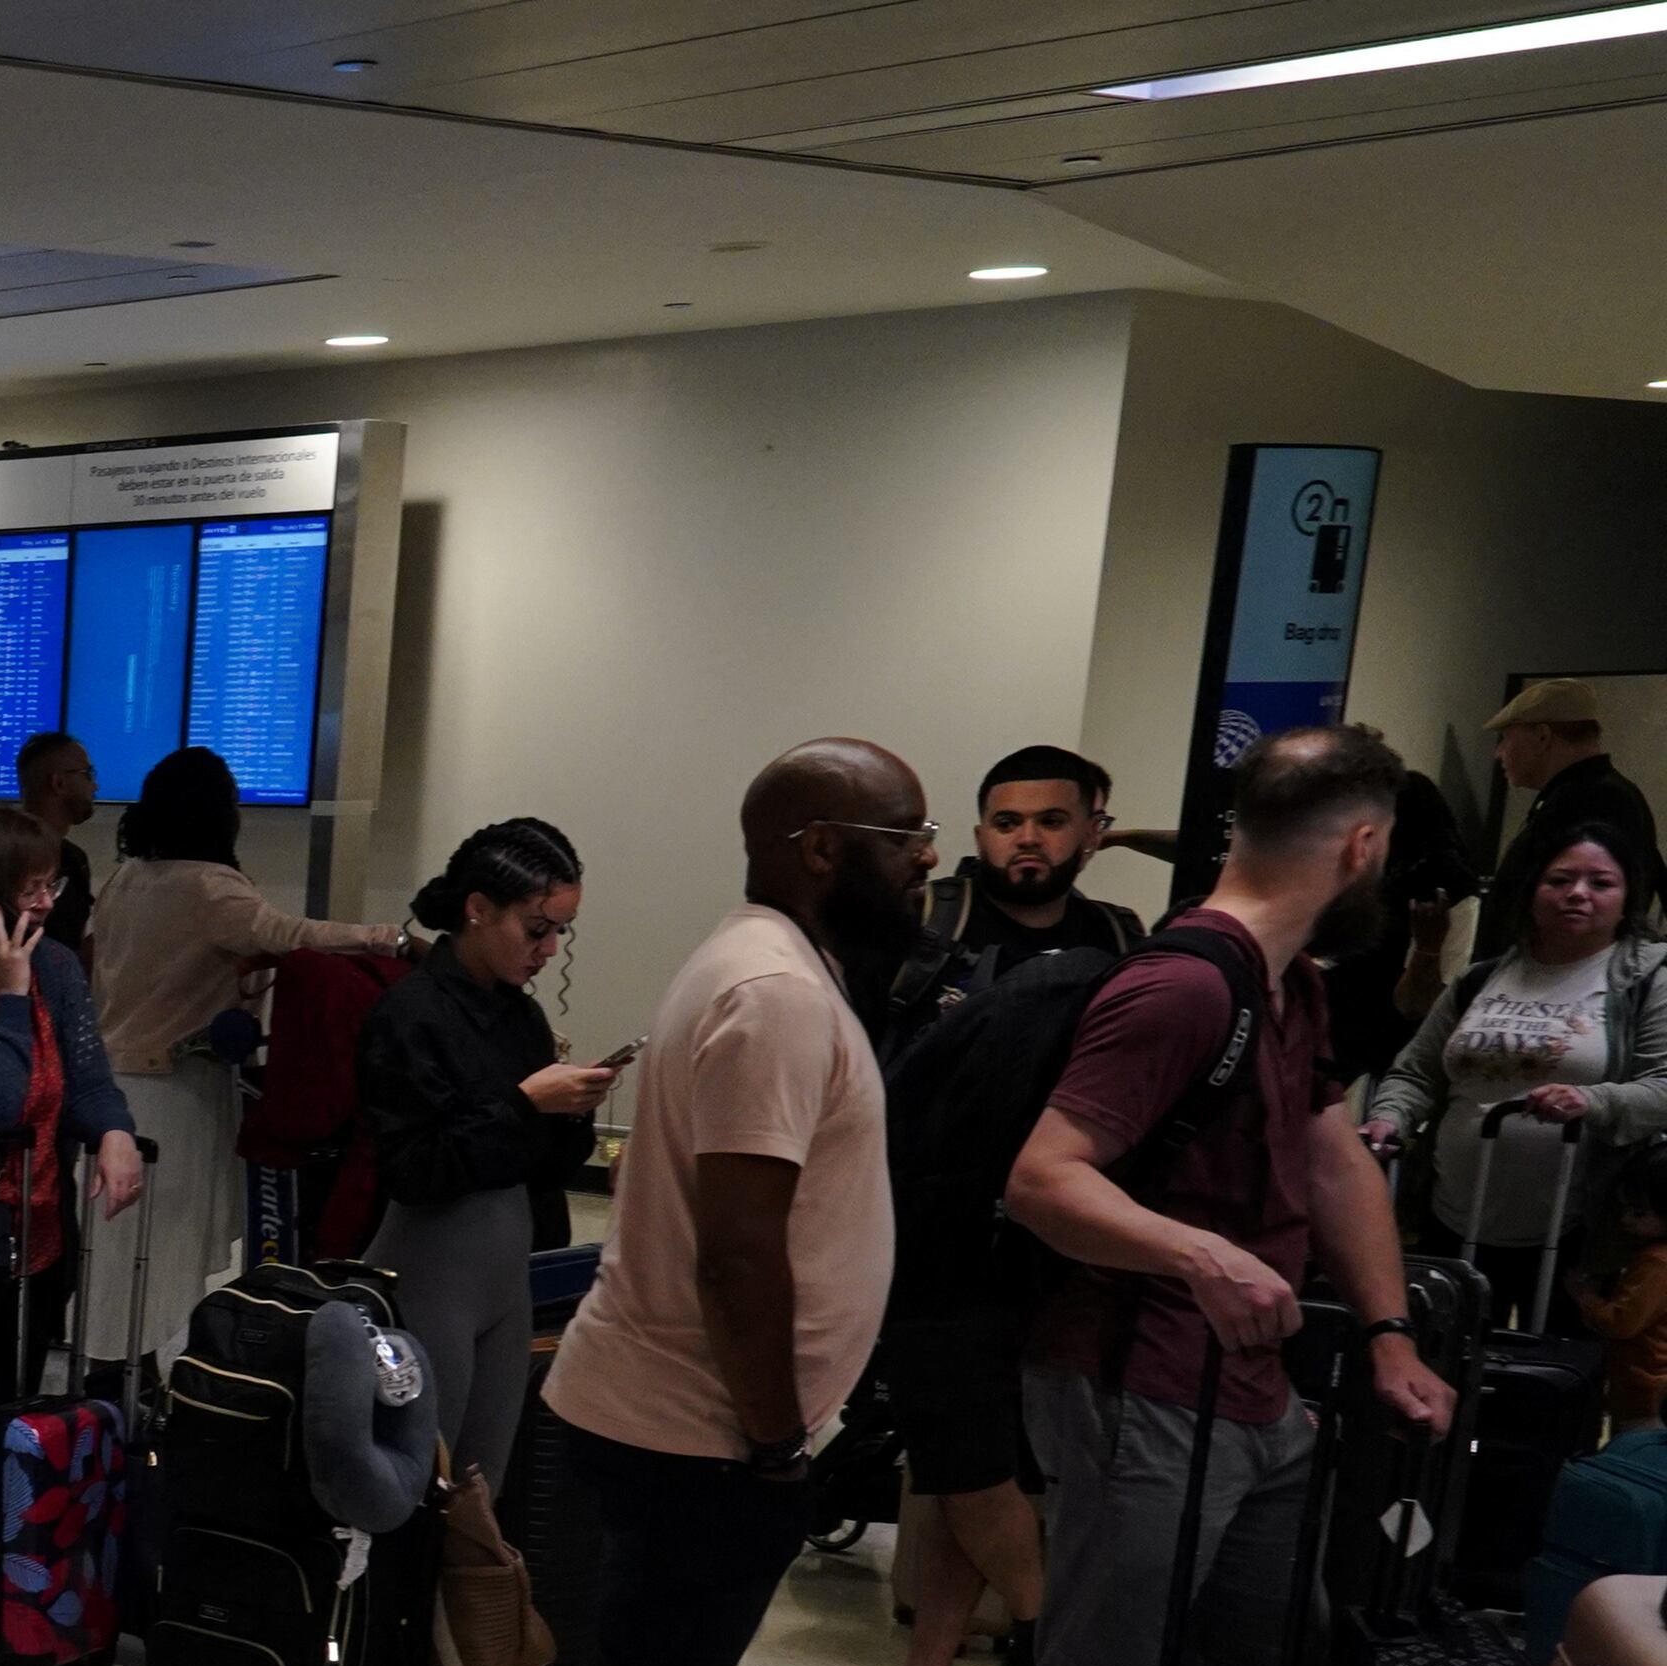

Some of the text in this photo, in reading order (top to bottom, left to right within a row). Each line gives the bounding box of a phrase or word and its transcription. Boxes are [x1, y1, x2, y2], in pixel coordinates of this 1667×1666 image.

[89, 465, 136, 479] Pasajeros
[137, 460, 180, 476] viajando
[190, 457, 234, 470] Destinos
[236, 448, 315, 466] Internacionales
[117, 479, 148, 492] deben
[150, 479, 174, 489] estar
[177, 477, 188, 487] en
[202, 473, 236, 488] puerta
[239, 468, 252, 482] de
[254, 466, 285, 481] salida
[146, 493, 188, 505] minutos
[189, 491, 218, 502] antes
[218, 488, 236, 500] del
[237, 485, 266, 499] vuelo
[1284, 622, 1316, 645] Bag
[1482, 998, 1569, 1018] THESE
[1514, 1020, 1549, 1032] THE
[1464, 1030, 1556, 1058] DAYS
